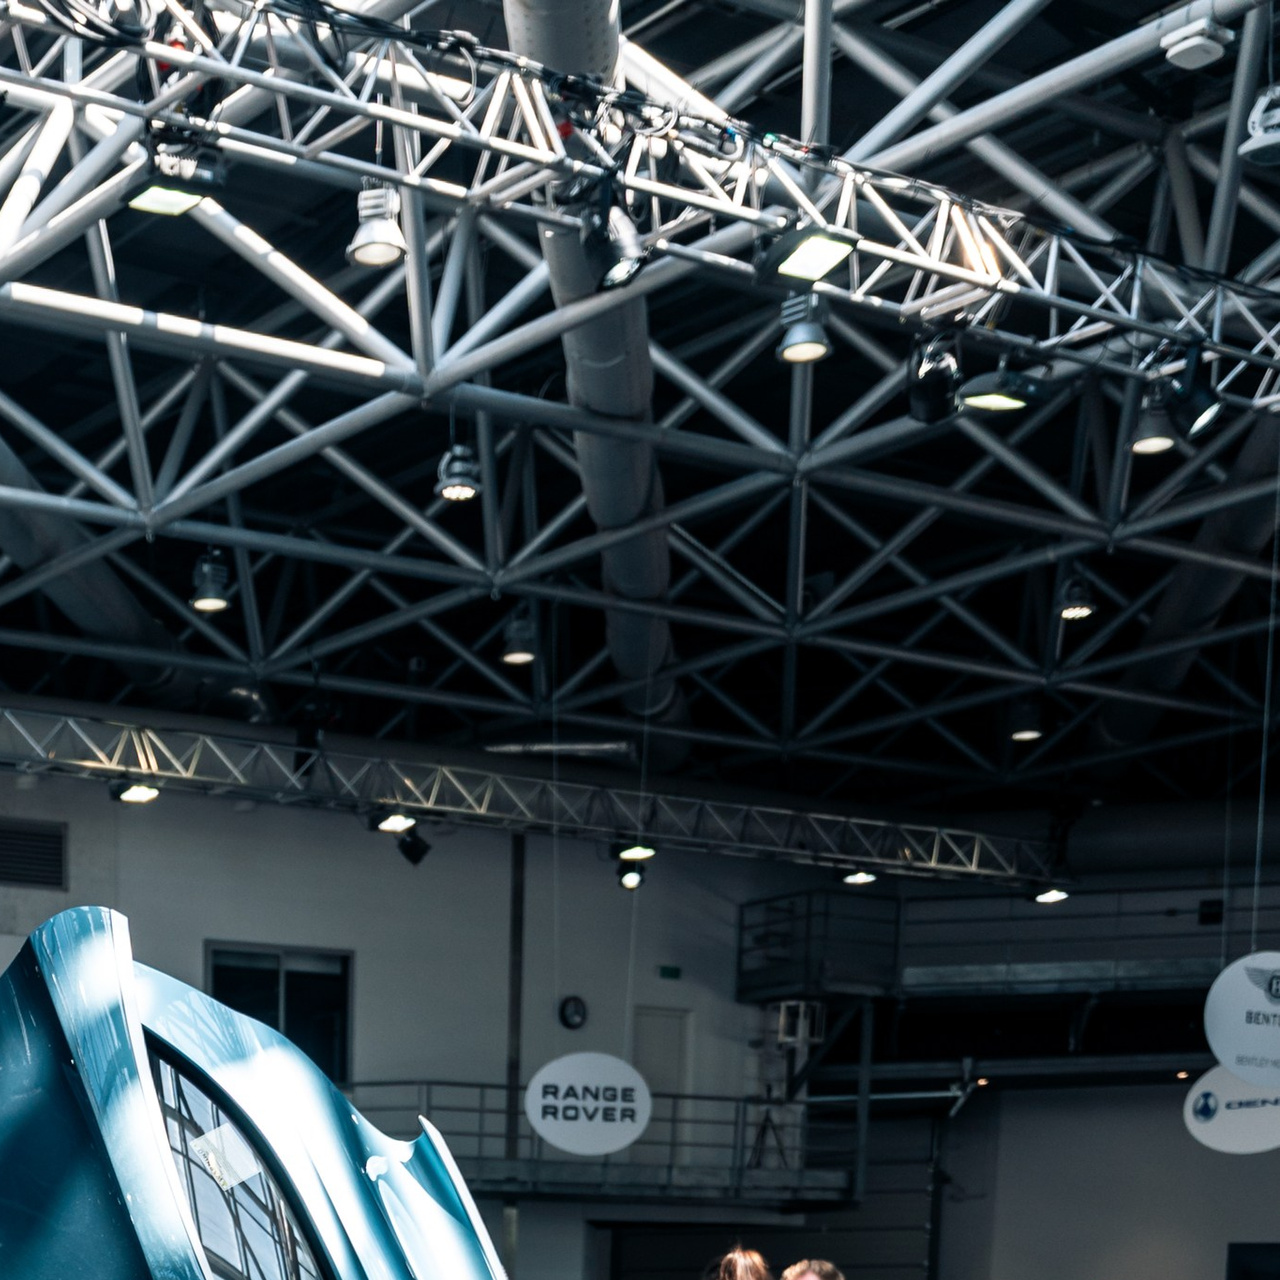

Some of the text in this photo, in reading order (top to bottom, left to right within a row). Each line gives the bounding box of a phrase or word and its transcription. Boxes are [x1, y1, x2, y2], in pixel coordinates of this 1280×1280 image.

[1245, 1010, 1280, 1027] BENT
[542, 1084, 635, 1103] RANGE
[541, 1104, 636, 1122] ROVER
